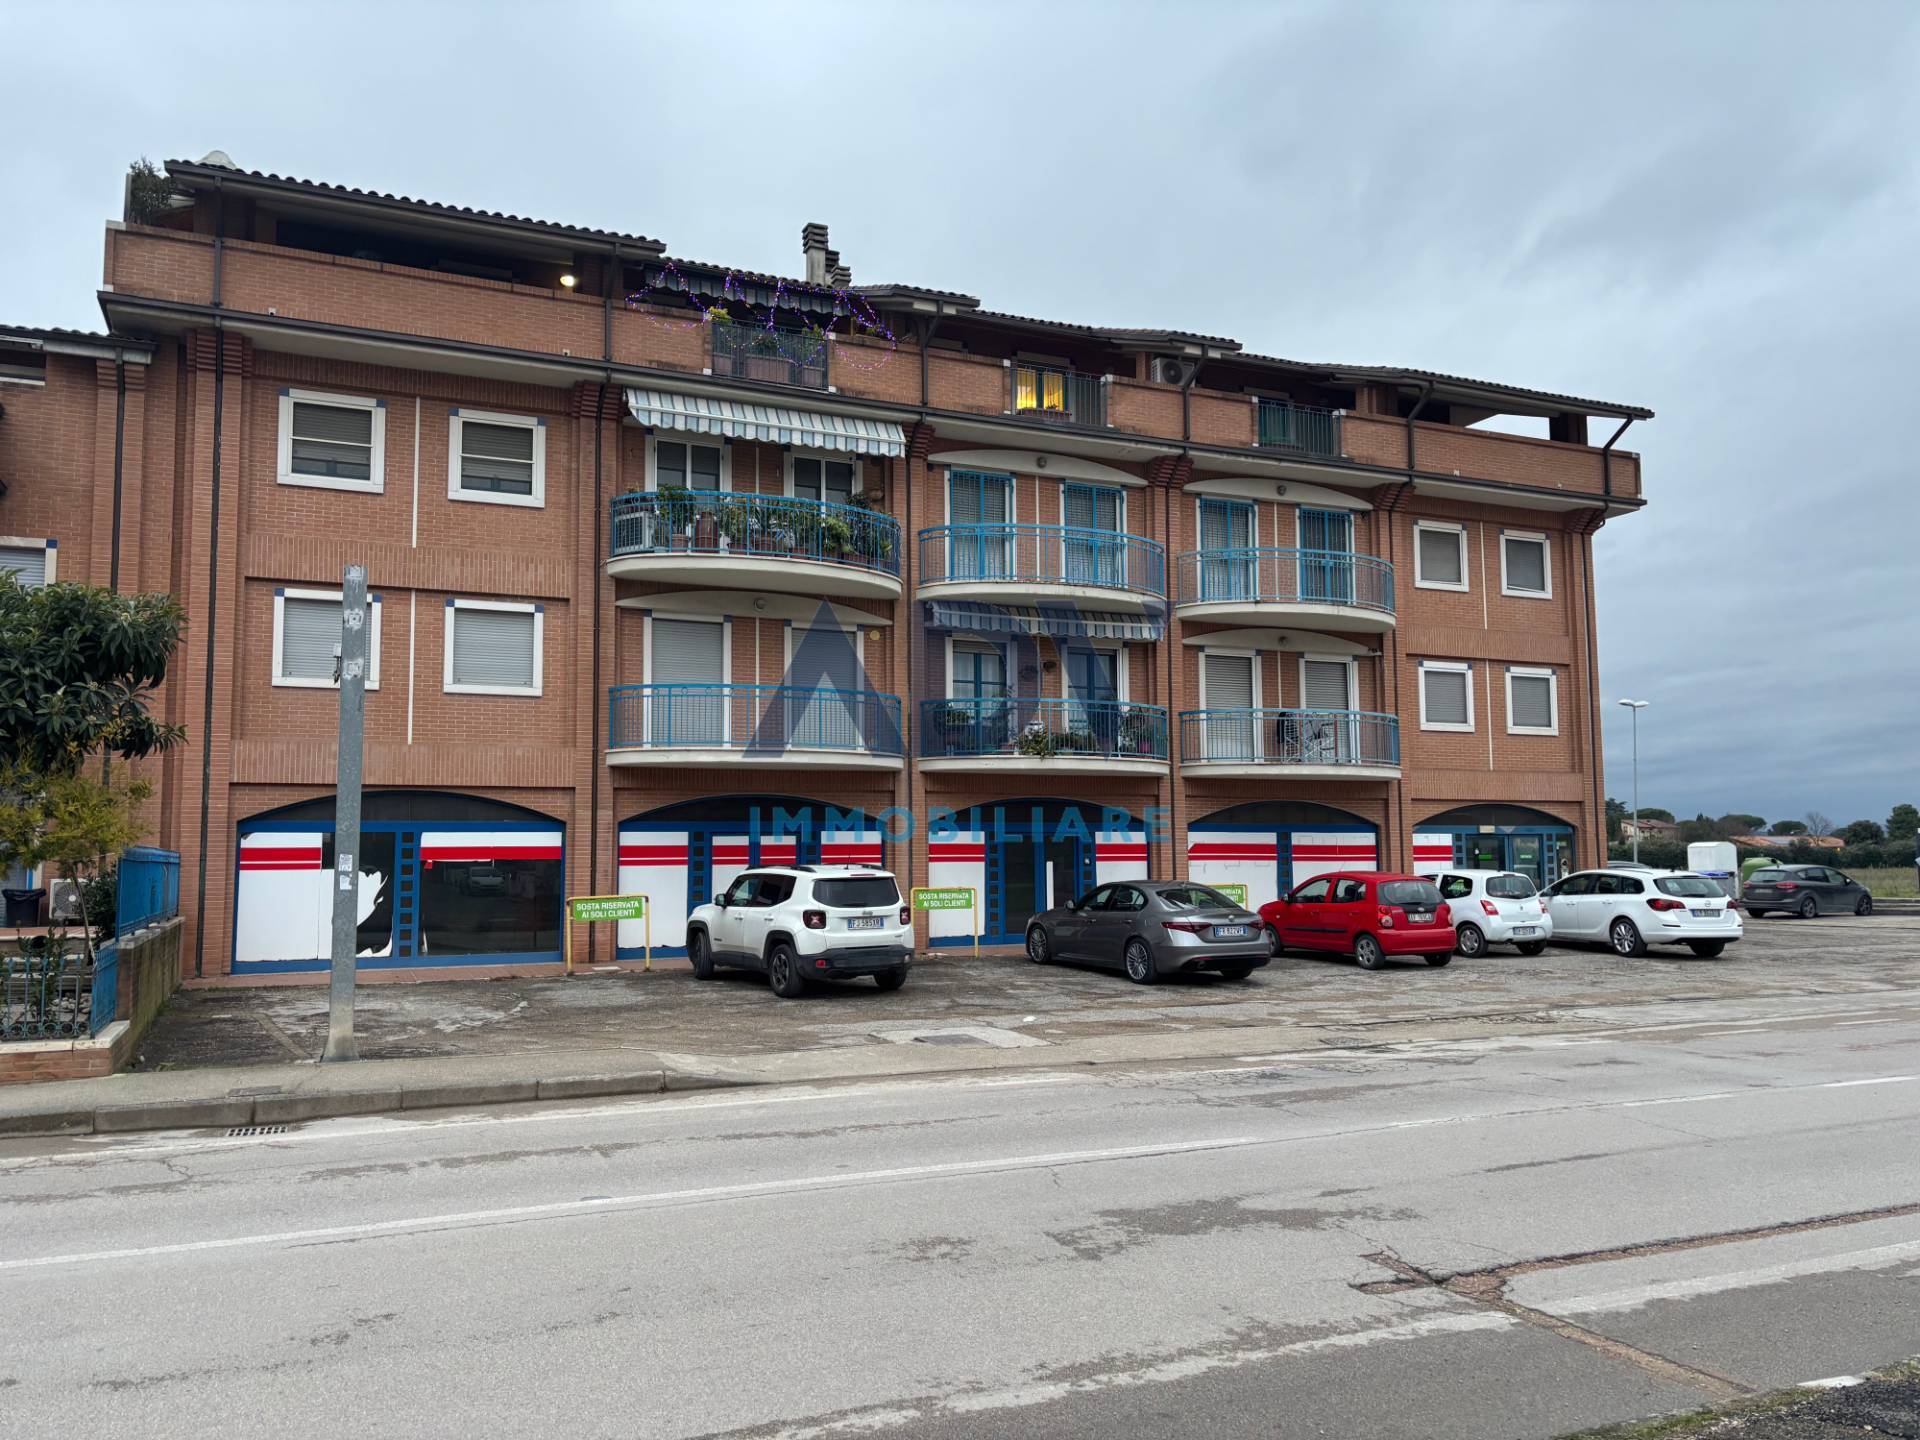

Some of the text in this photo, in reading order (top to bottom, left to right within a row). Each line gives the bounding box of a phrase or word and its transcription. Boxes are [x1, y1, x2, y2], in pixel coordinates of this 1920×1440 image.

[938, 892, 969, 900] RISERVATA
[576, 900, 640, 911] SOSTA RISERVATA
[943, 899, 966, 907] CLIENTI
[581, 909, 635, 919] AI SOLI CLIENTI
